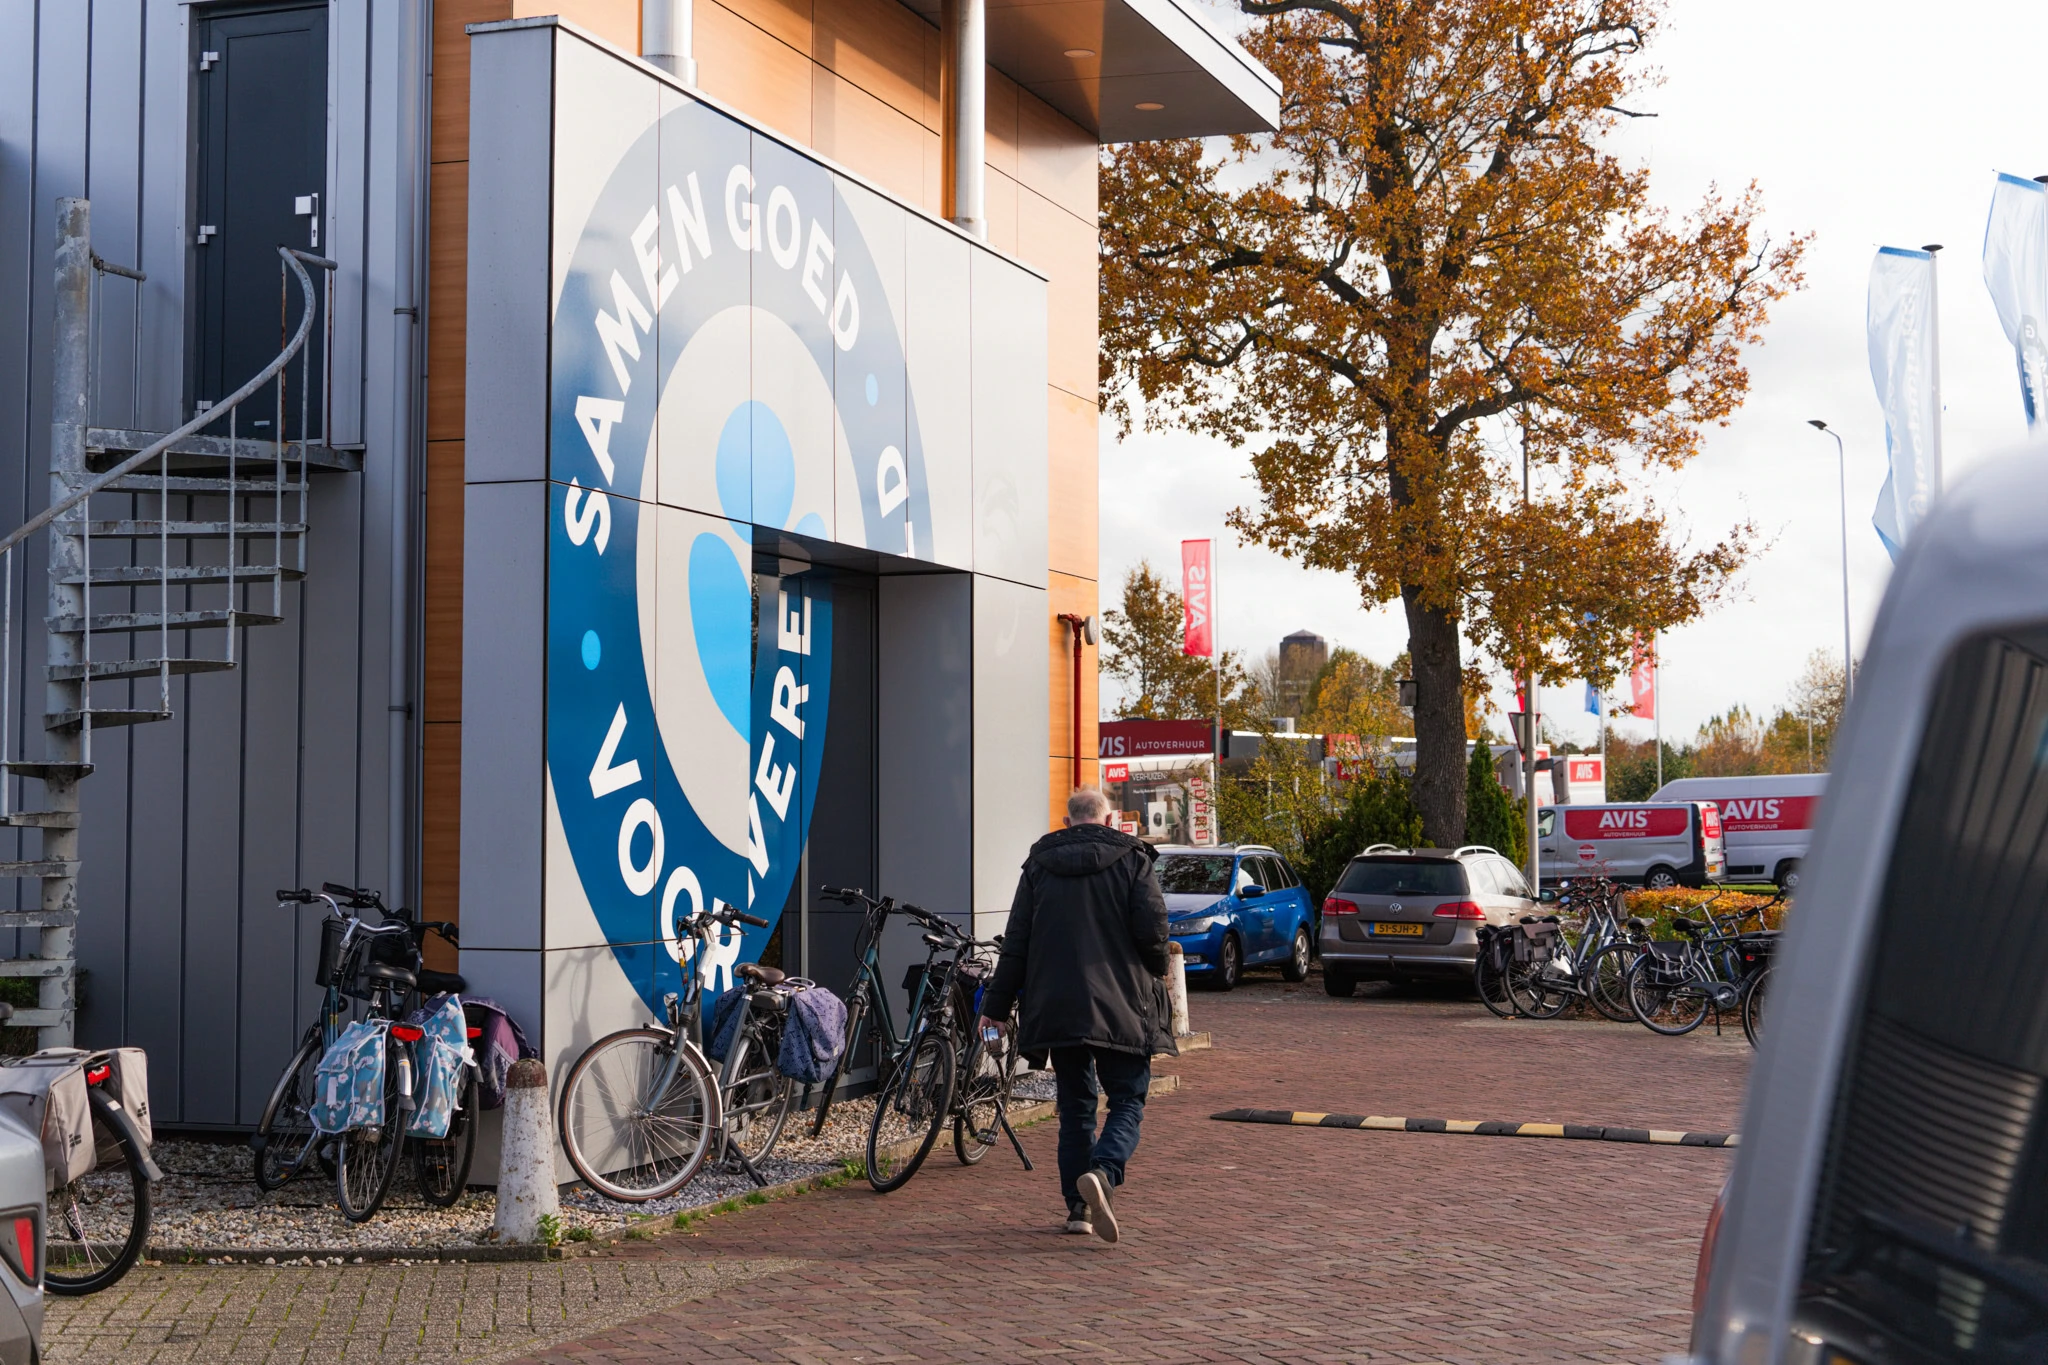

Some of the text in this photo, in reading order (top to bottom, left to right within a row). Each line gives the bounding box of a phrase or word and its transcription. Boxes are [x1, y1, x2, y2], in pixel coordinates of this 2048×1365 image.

[564, 164, 860, 556] SAMEN GOED
[1099, 736, 1205, 756] VIS AUTOVERHUUR
[1108, 768, 1127, 778] AVIS
[1576, 764, 1593, 779] AVIS
[1723, 799, 1780, 819] AVIS
[1599, 811, 1648, 829] AVIS
[589, 701, 742, 992] VOOR
[1379, 924, 1418, 934] 51-SJH-2
